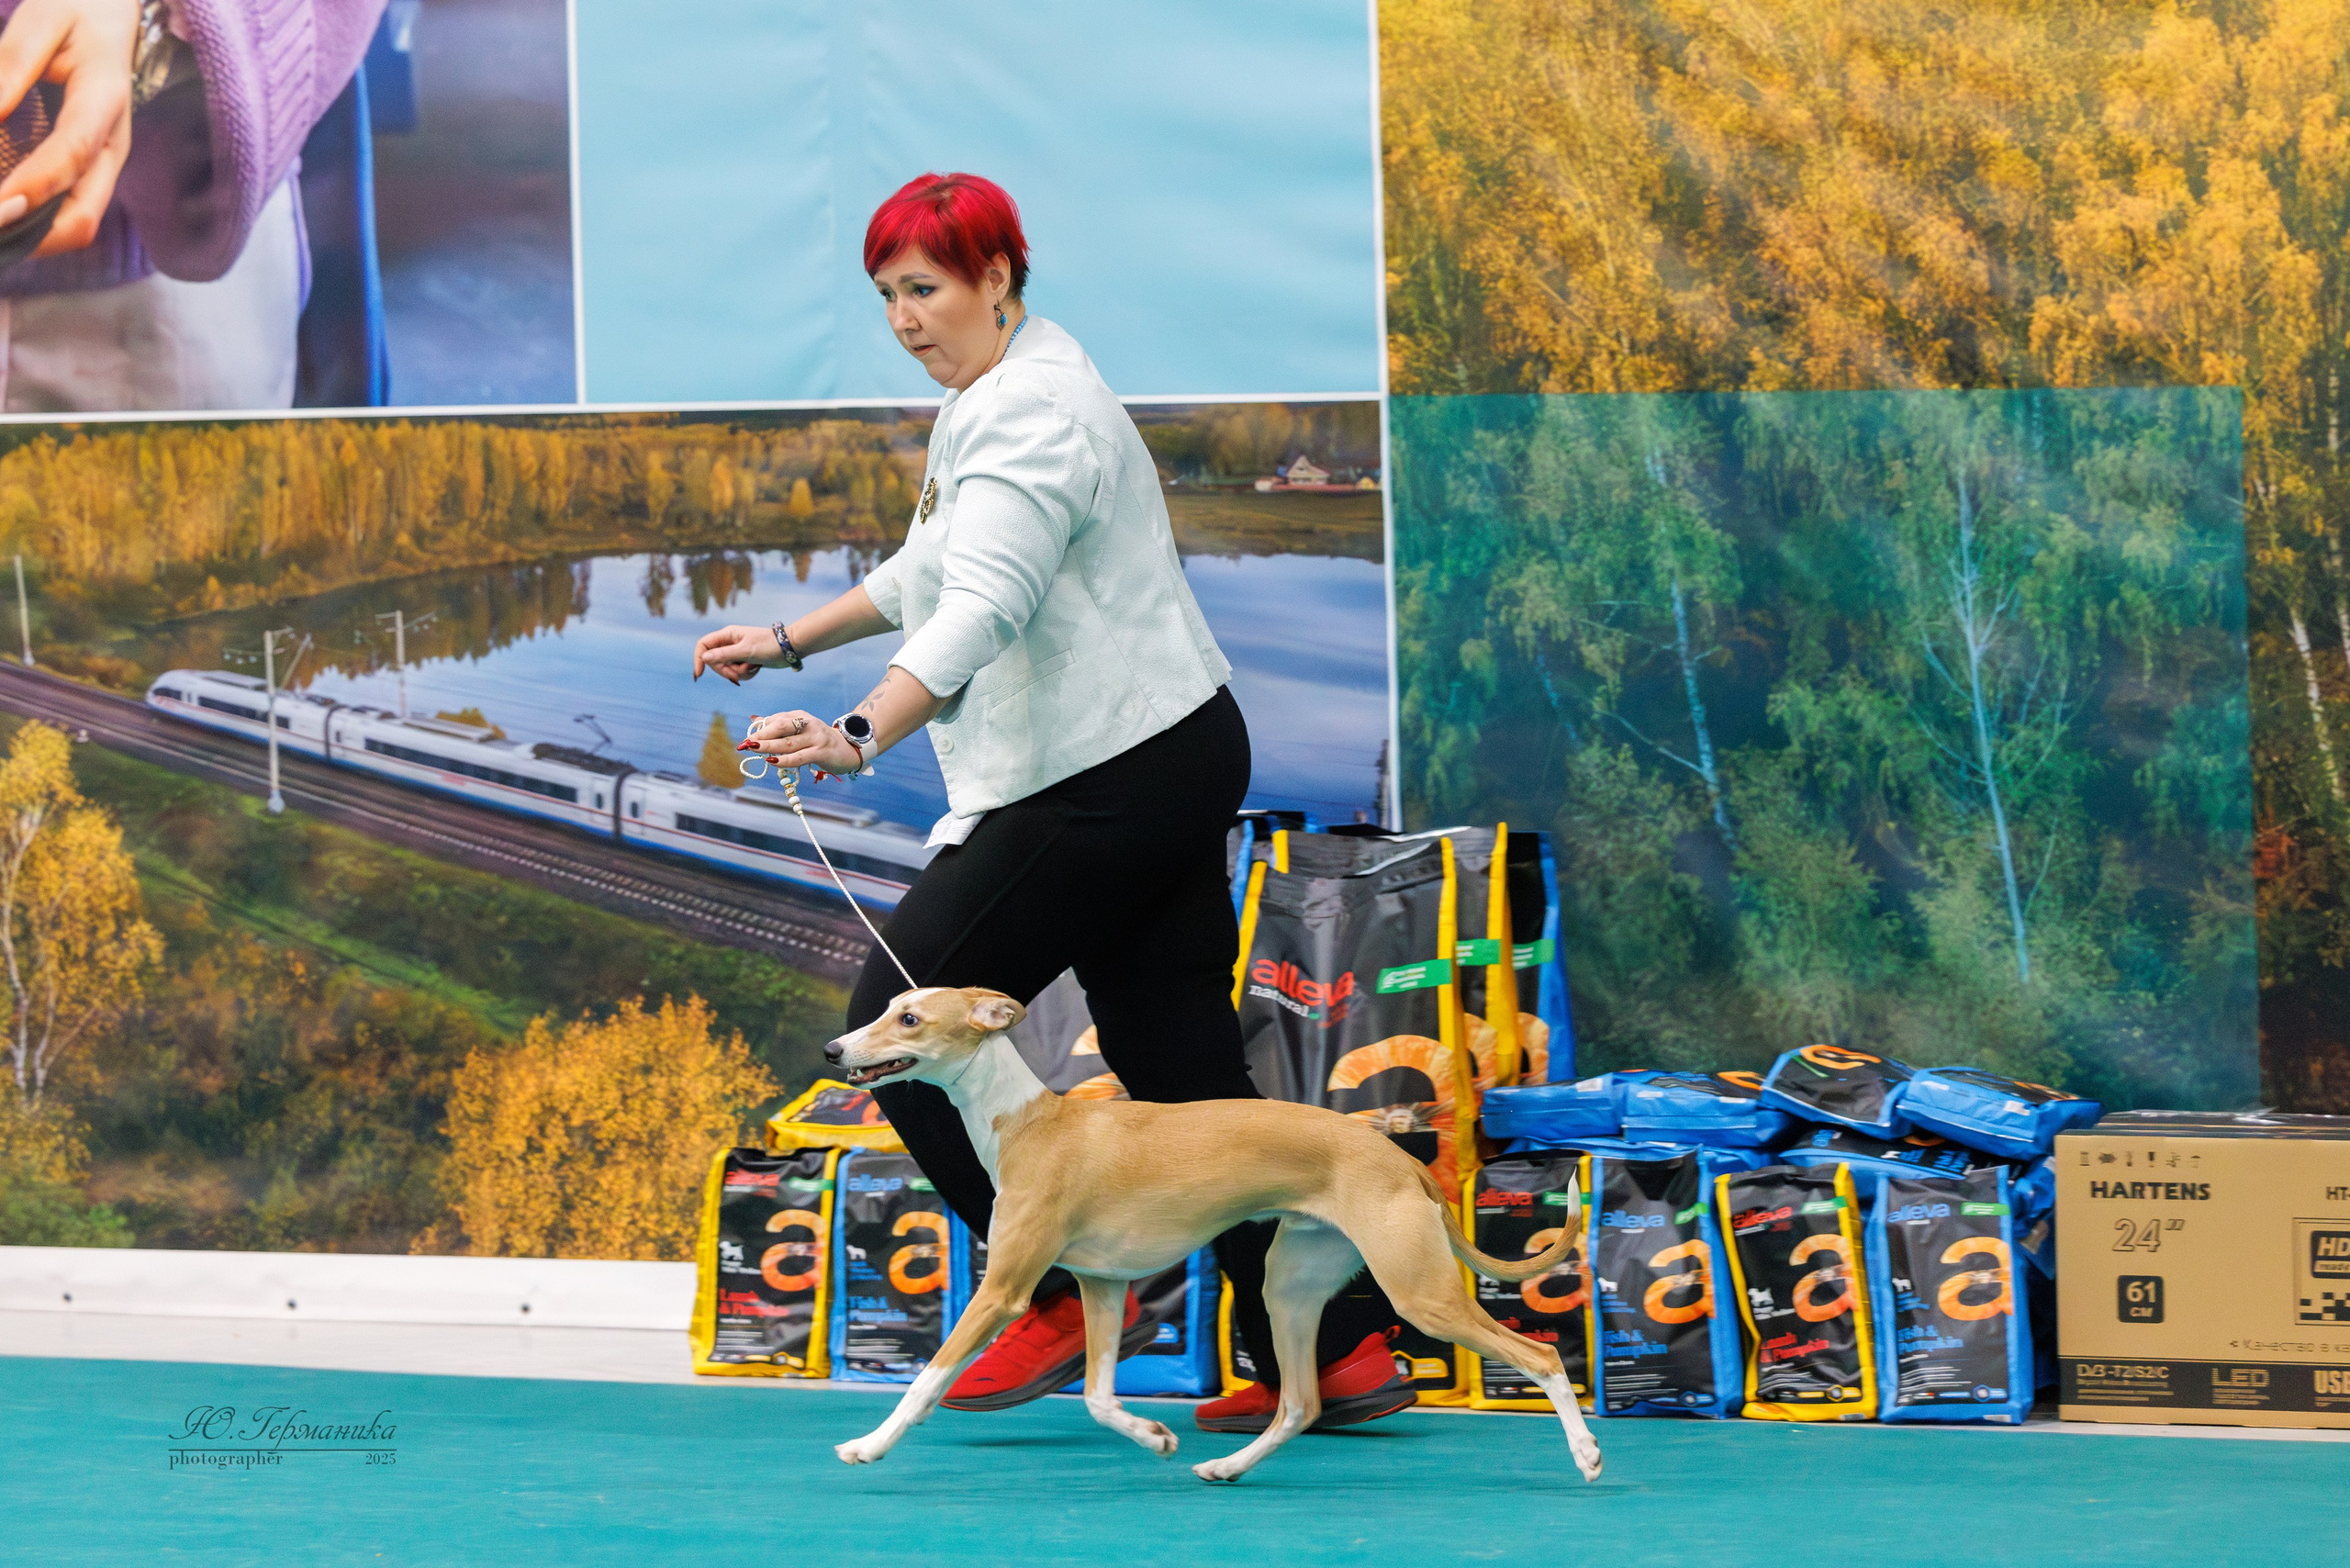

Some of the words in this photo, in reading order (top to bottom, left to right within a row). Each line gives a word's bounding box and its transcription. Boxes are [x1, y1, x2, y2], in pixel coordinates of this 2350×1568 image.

[1251, 958, 1355, 1007] alleva
[2090, 1181, 2211, 1201] HARTENS
[760, 1208, 828, 1293] a
[889, 1210, 951, 1295] a
[1643, 1238, 1716, 1325] a
[1789, 1234, 1859, 1323] a
[1938, 1236, 2014, 1321] a
[2125, 1281, 2156, 1304] 61
[2211, 1368, 2270, 1387] LED
